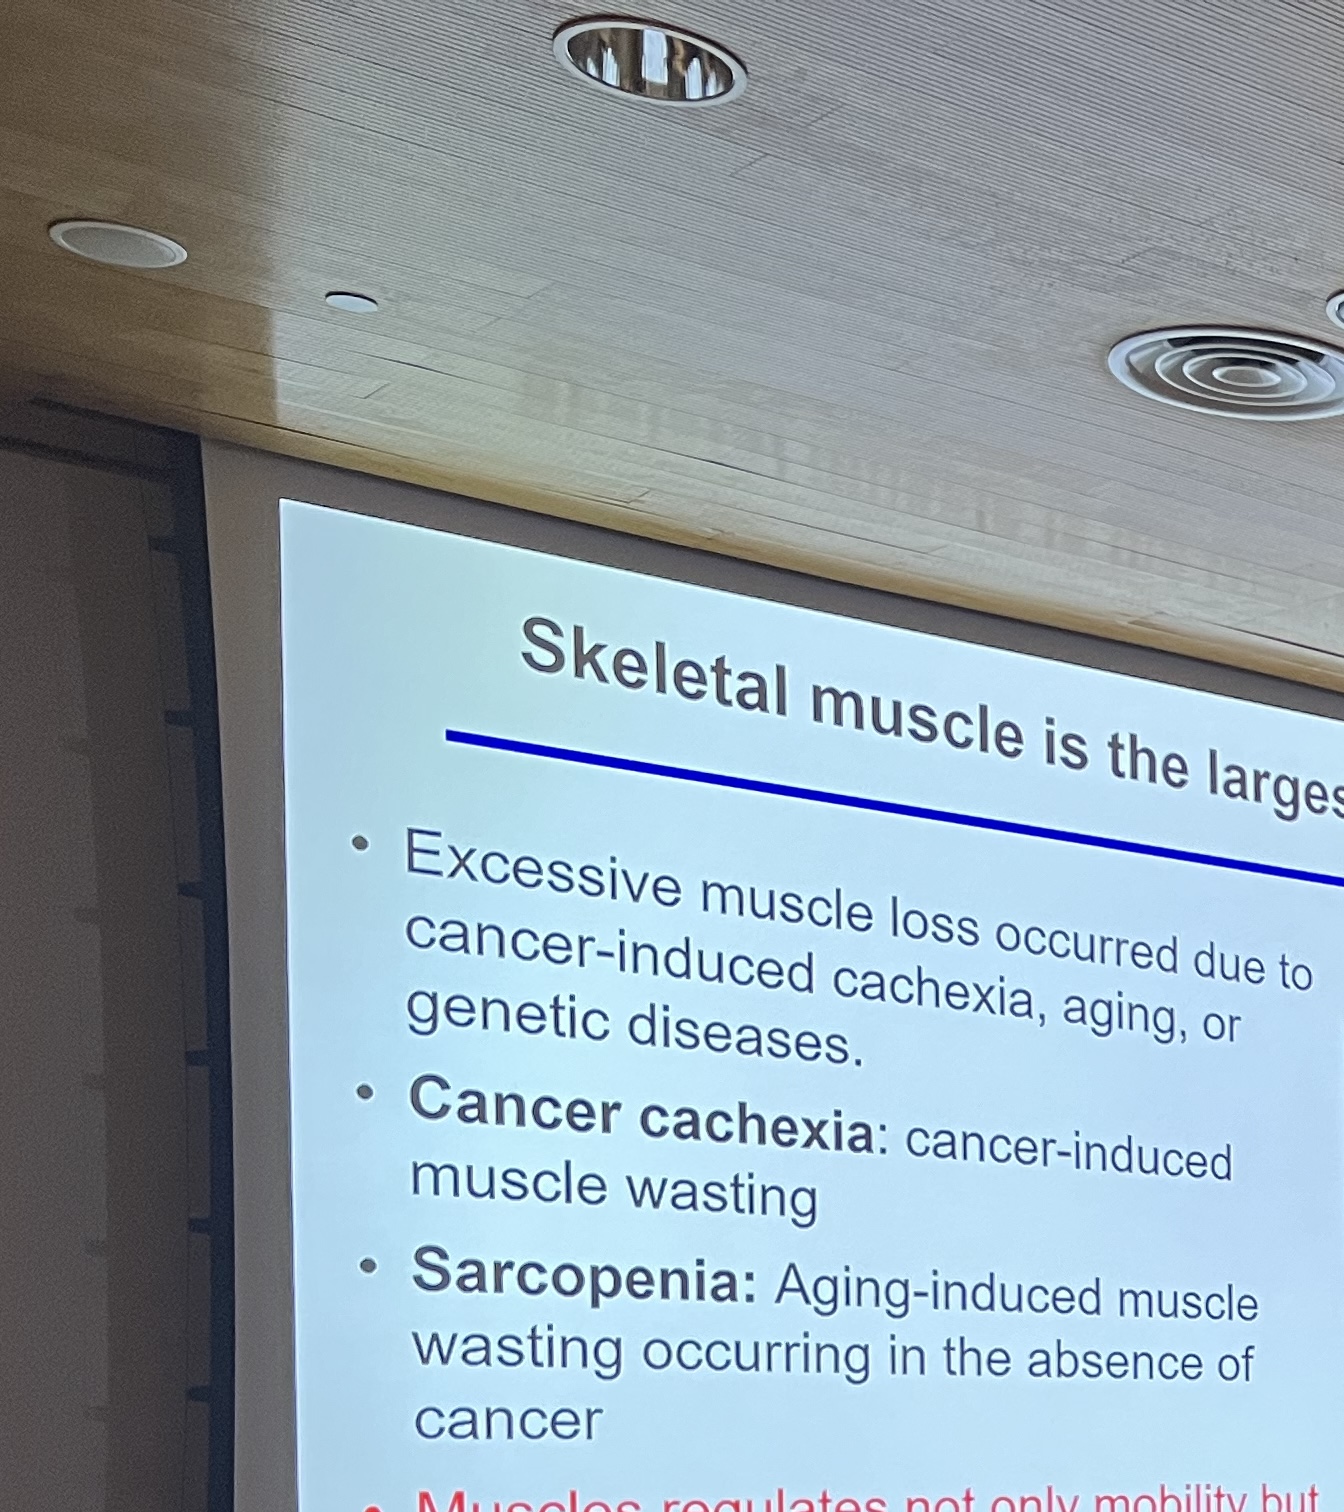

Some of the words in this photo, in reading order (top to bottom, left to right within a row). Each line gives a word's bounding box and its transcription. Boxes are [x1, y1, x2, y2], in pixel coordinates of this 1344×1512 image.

[520, 616, 788, 718] Skeletal
[811, 683, 1025, 759] muscle
[1045, 715, 1089, 771] is
[1106, 731, 1190, 790] the
[406, 826, 682, 908] Excessive
[701, 879, 874, 933] muscle
[891, 895, 980, 948] loss
[995, 922, 1178, 976] occurred
[1193, 940, 1266, 985] due
[1277, 953, 1313, 992] to
[405, 912, 814, 994] cancer-induced
[833, 964, 1046, 1028] cachexia,
[1063, 989, 1187, 1045] aging,
[1202, 1012, 1242, 1043] or
[406, 989, 611, 1042] genetic
[627, 1001, 862, 1068] diseases.
[409, 1073, 623, 1134] Cancer
[639, 1100, 887, 1156] cachexia:
[905, 1127, 1232, 1182] cancer-induced
[411, 1158, 608, 1206] muscle
[624, 1171, 817, 1230] wasting
[412, 1244, 755, 1310] Sarcopenia:
[774, 1262, 1101, 1320] Aging-induced
[1118, 1282, 1259, 1322] muscle
[411, 1322, 622, 1381] wasting
[642, 1330, 870, 1386] occurring
[889, 1332, 926, 1376] in
[941, 1335, 1012, 1378] the
[1027, 1338, 1204, 1381] absence
[1217, 1344, 1256, 1382] of
[414, 1406, 604, 1441] cancer
